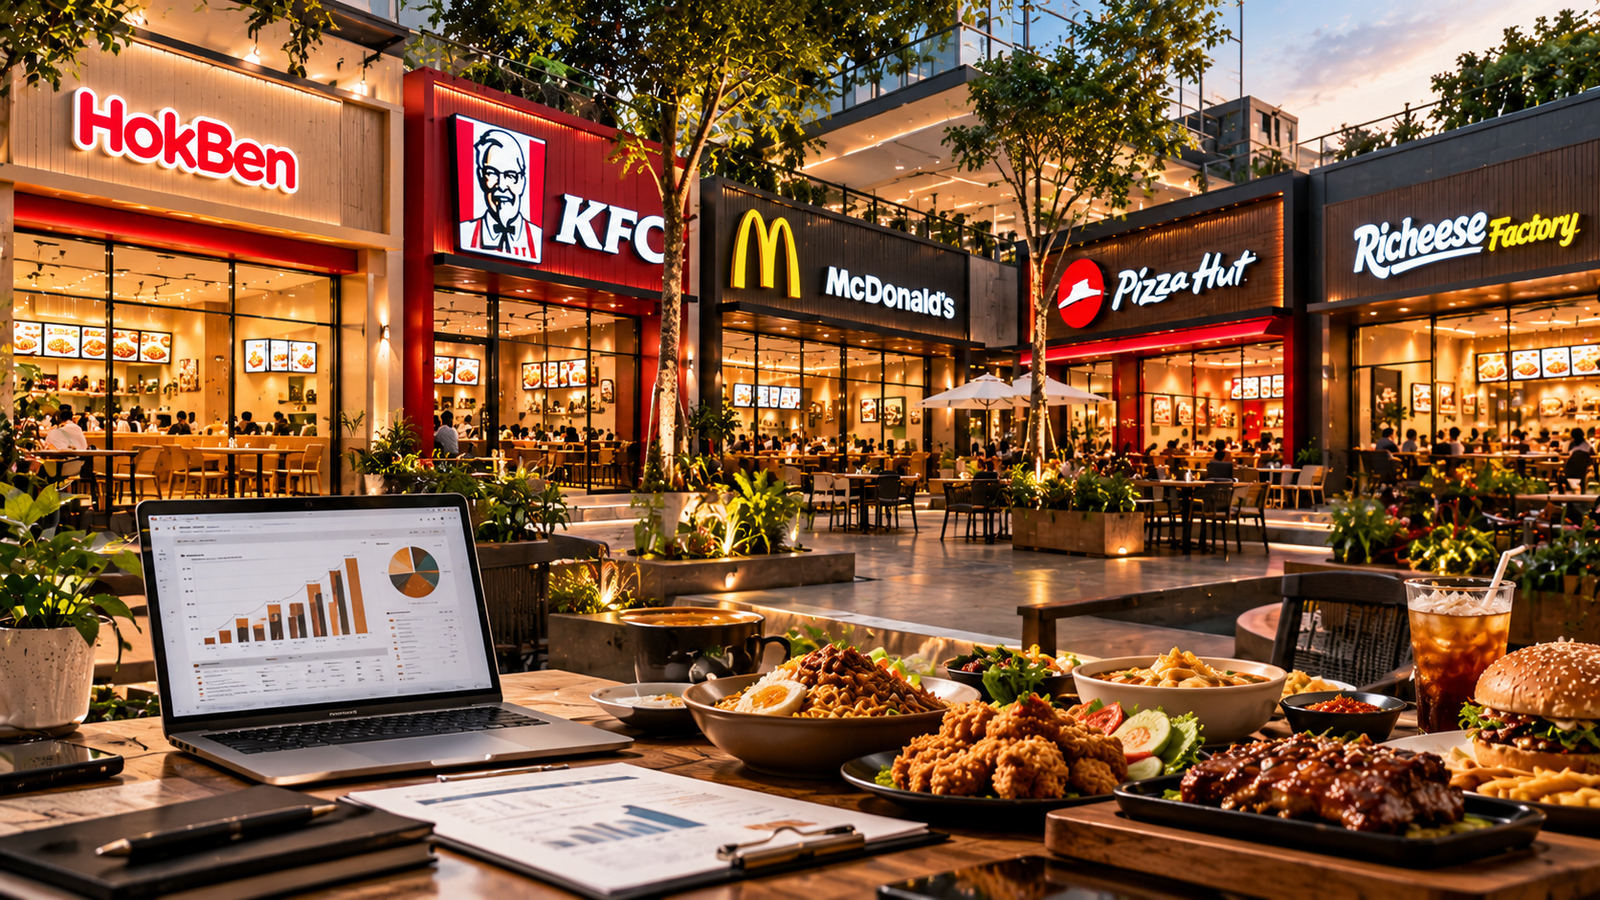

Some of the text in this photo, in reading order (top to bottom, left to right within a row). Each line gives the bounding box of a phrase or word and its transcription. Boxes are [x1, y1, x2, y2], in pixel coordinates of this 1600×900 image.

[76, 88, 298, 193] HokBen
[556, 193, 665, 264] KFC
[1353, 211, 1580, 279] Richeese Factory
[825, 265, 955, 320] McDonald's
[1111, 249, 1257, 311] Pizza Hut
